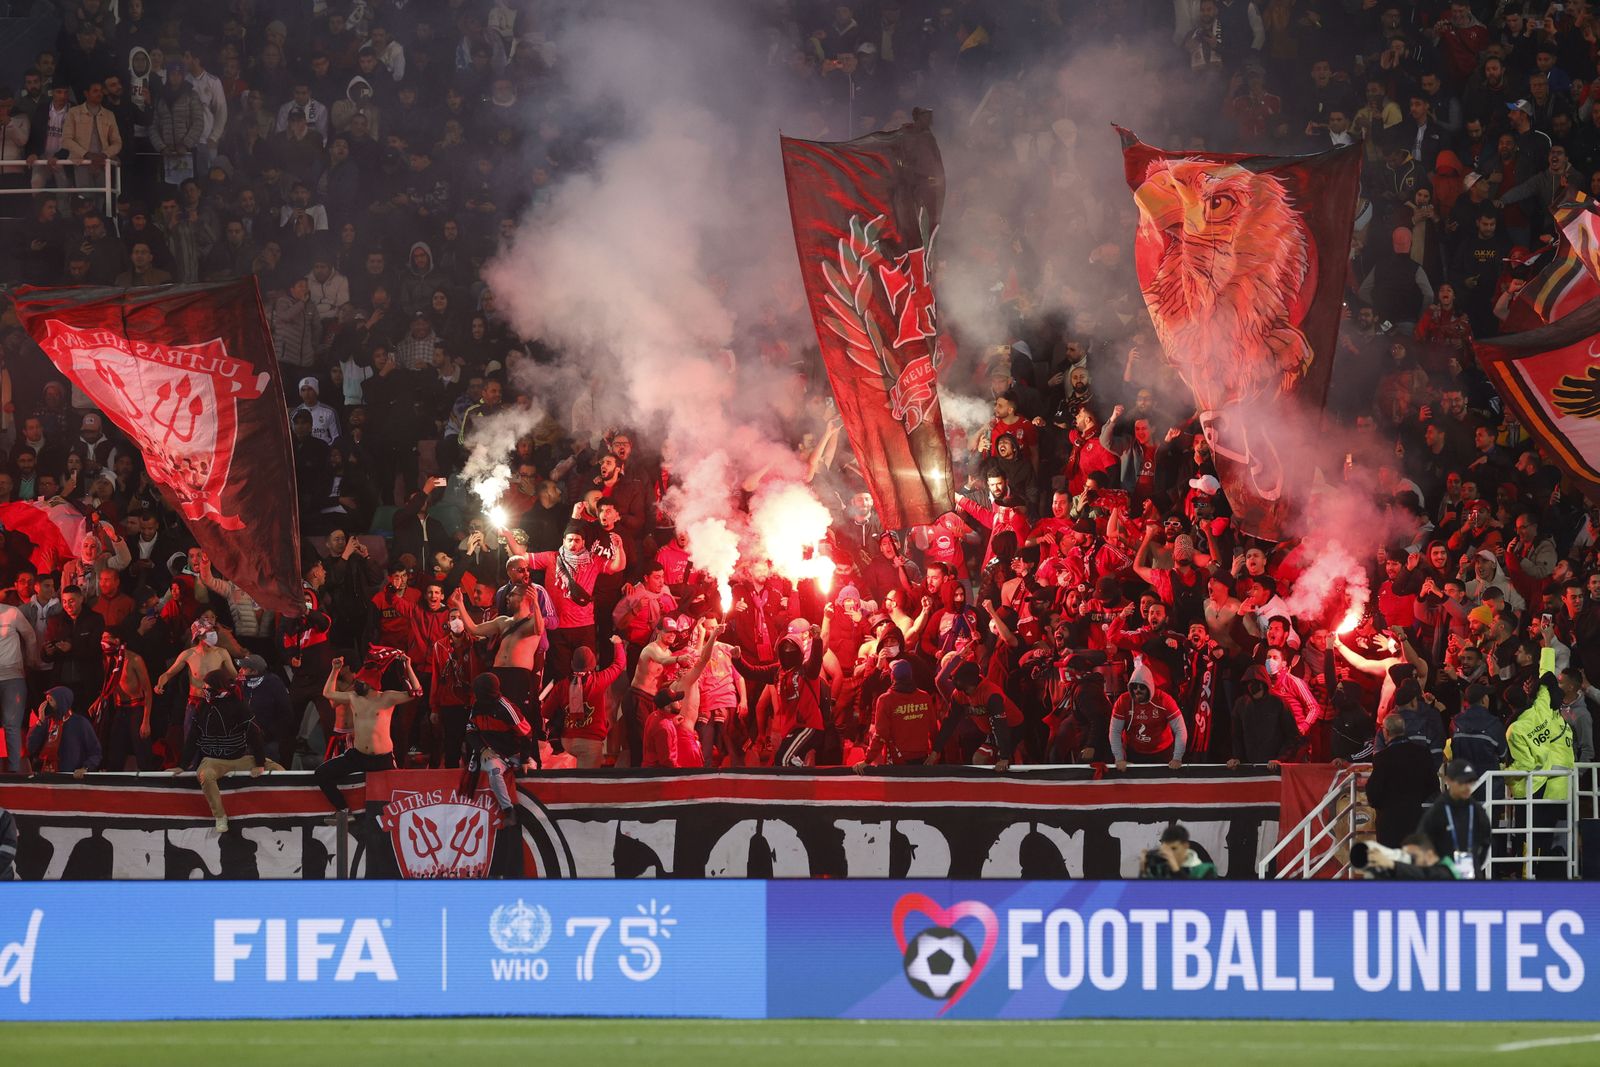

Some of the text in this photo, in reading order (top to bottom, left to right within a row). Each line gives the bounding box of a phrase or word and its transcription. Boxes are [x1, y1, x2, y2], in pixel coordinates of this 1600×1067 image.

[598, 545, 611, 560] 74
[386, 789, 443, 816] ULTRAS
[214, 919, 398, 981] FIFA
[491, 958, 549, 981] WHO
[566, 917, 662, 981] 75
[1008, 908, 1586, 993] FOOTBALL UNITES
